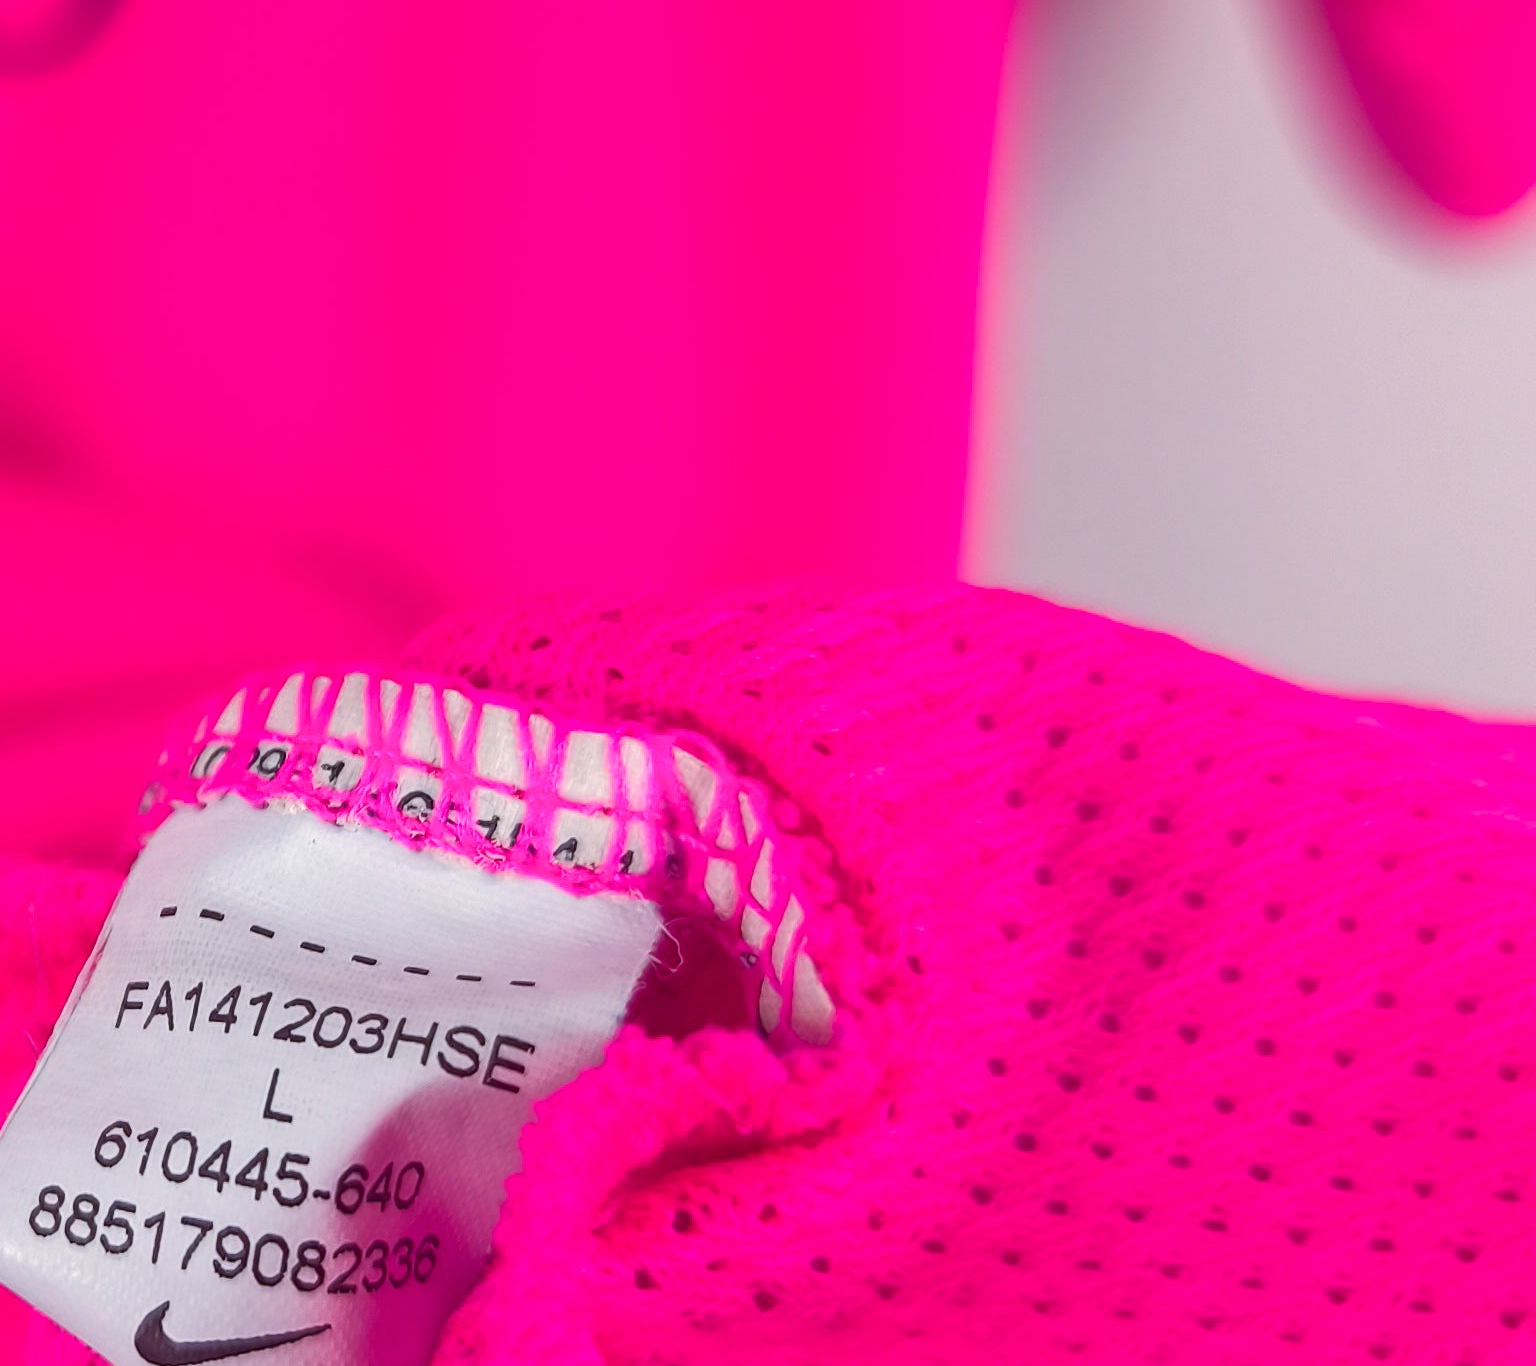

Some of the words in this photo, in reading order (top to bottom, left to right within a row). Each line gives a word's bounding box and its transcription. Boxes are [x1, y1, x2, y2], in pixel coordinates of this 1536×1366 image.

[115, 979, 536, 1094] FA141203HSE
[262, 1067, 294, 1124] L
[94, 1120, 426, 1215] 610445-640
[28, 1184, 441, 1295] 885179082336
